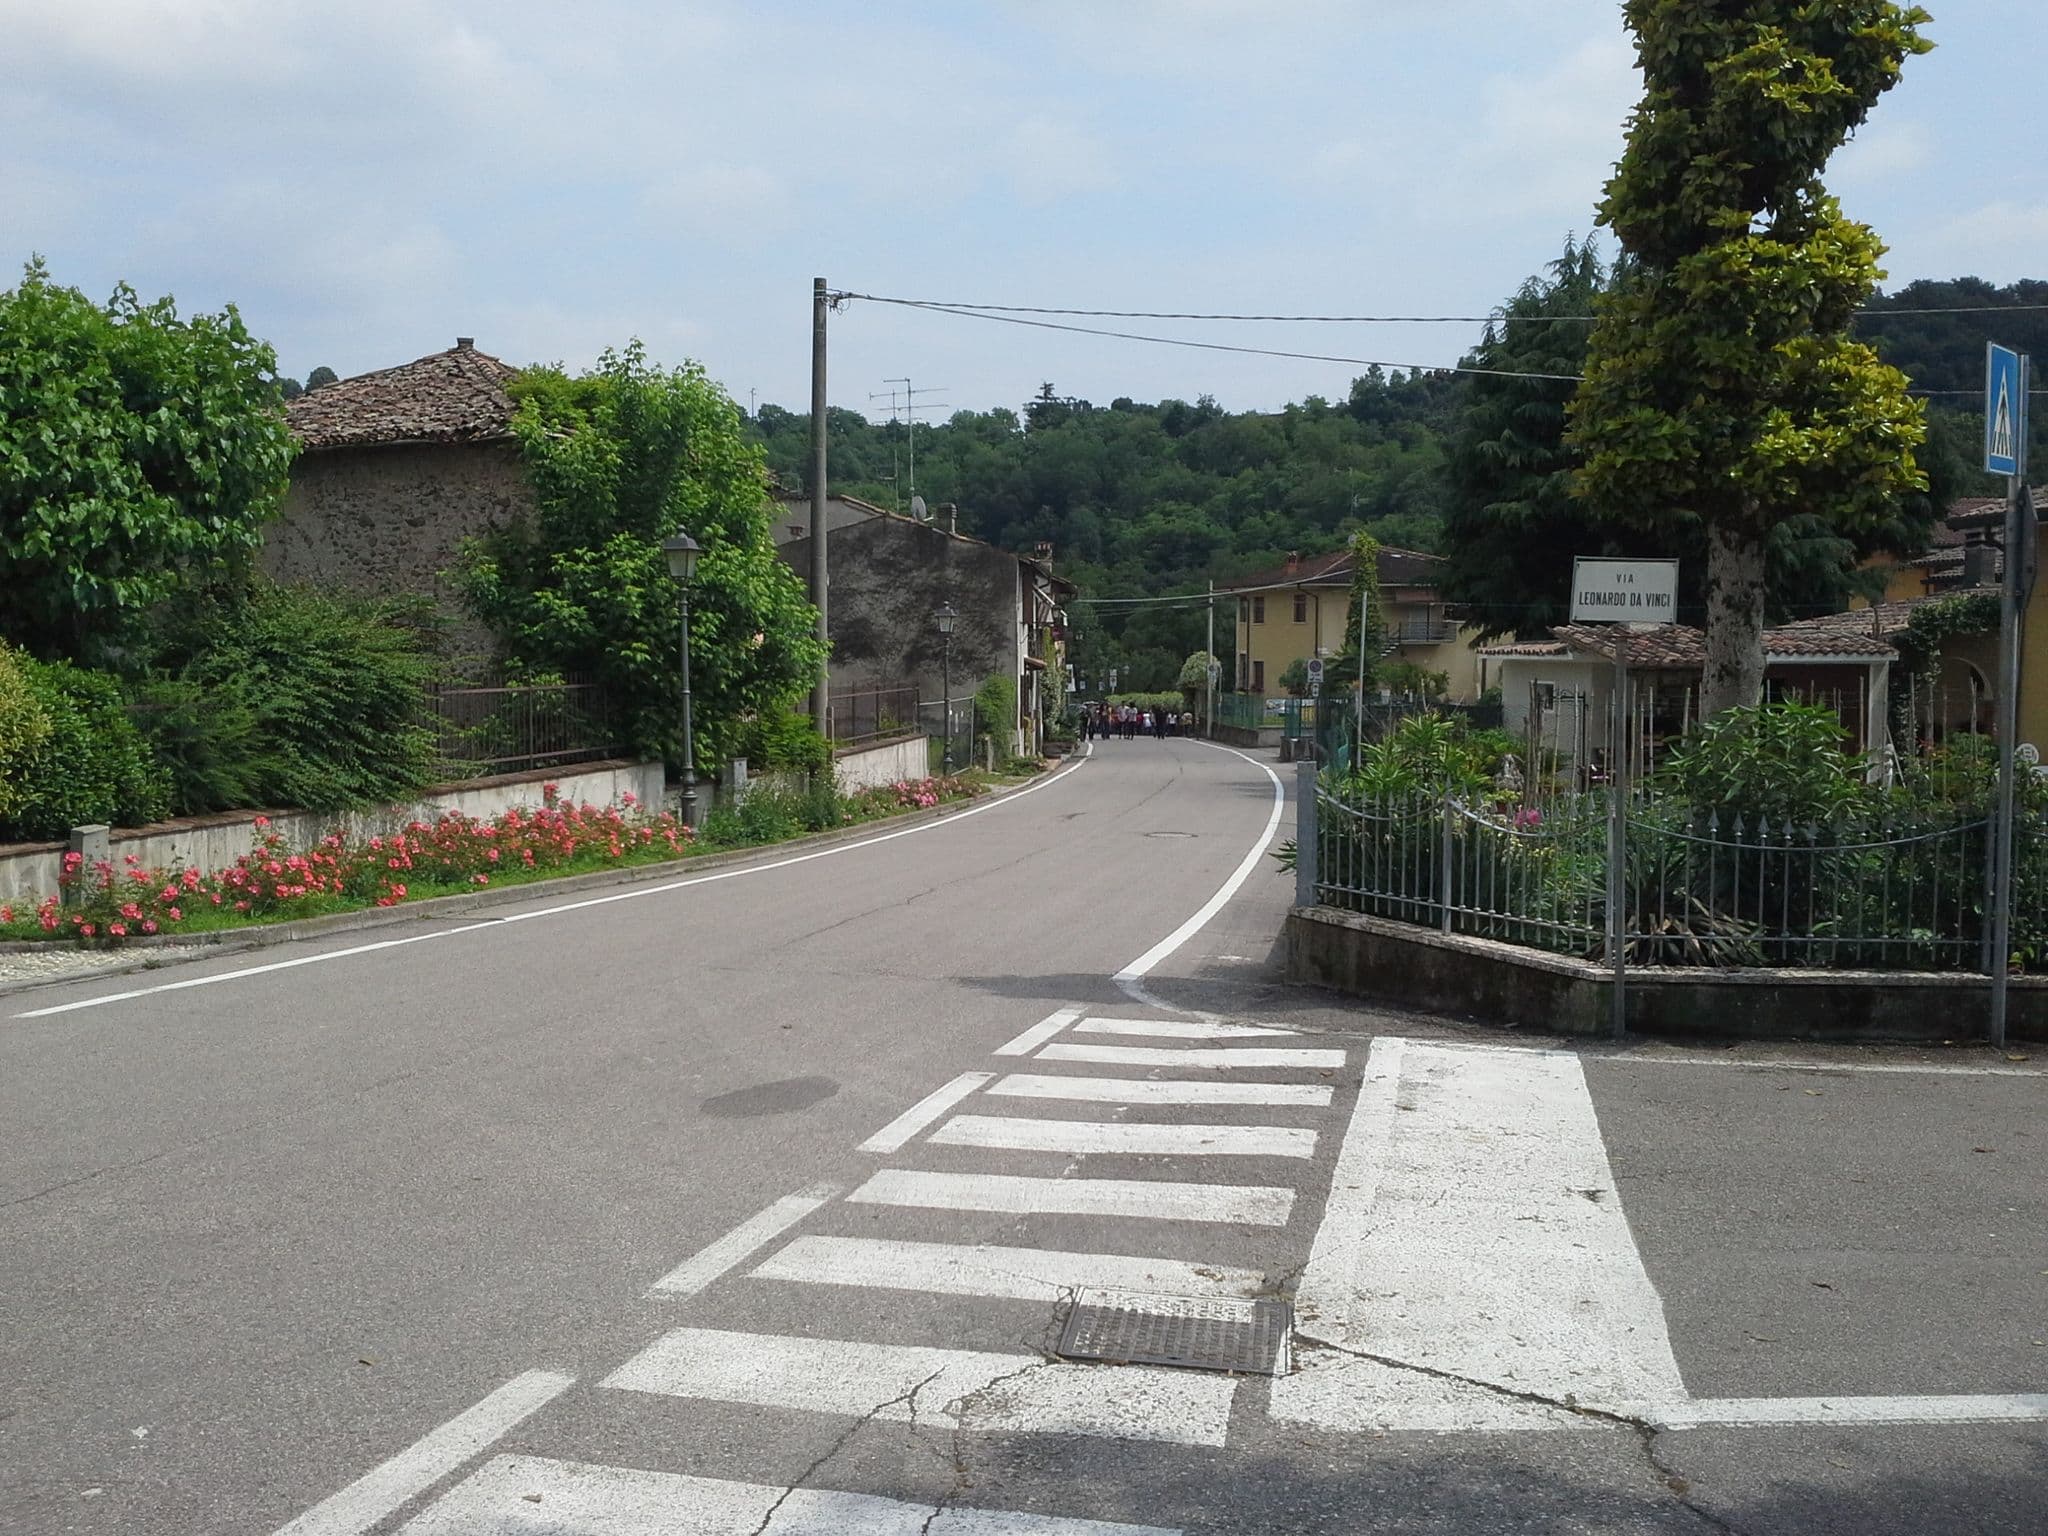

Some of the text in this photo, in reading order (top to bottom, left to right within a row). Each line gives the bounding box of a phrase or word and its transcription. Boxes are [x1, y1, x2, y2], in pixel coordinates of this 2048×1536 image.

[1616, 574, 1633, 583] VIA
[1579, 592, 1671, 607] LEONARDO DA VINCI
